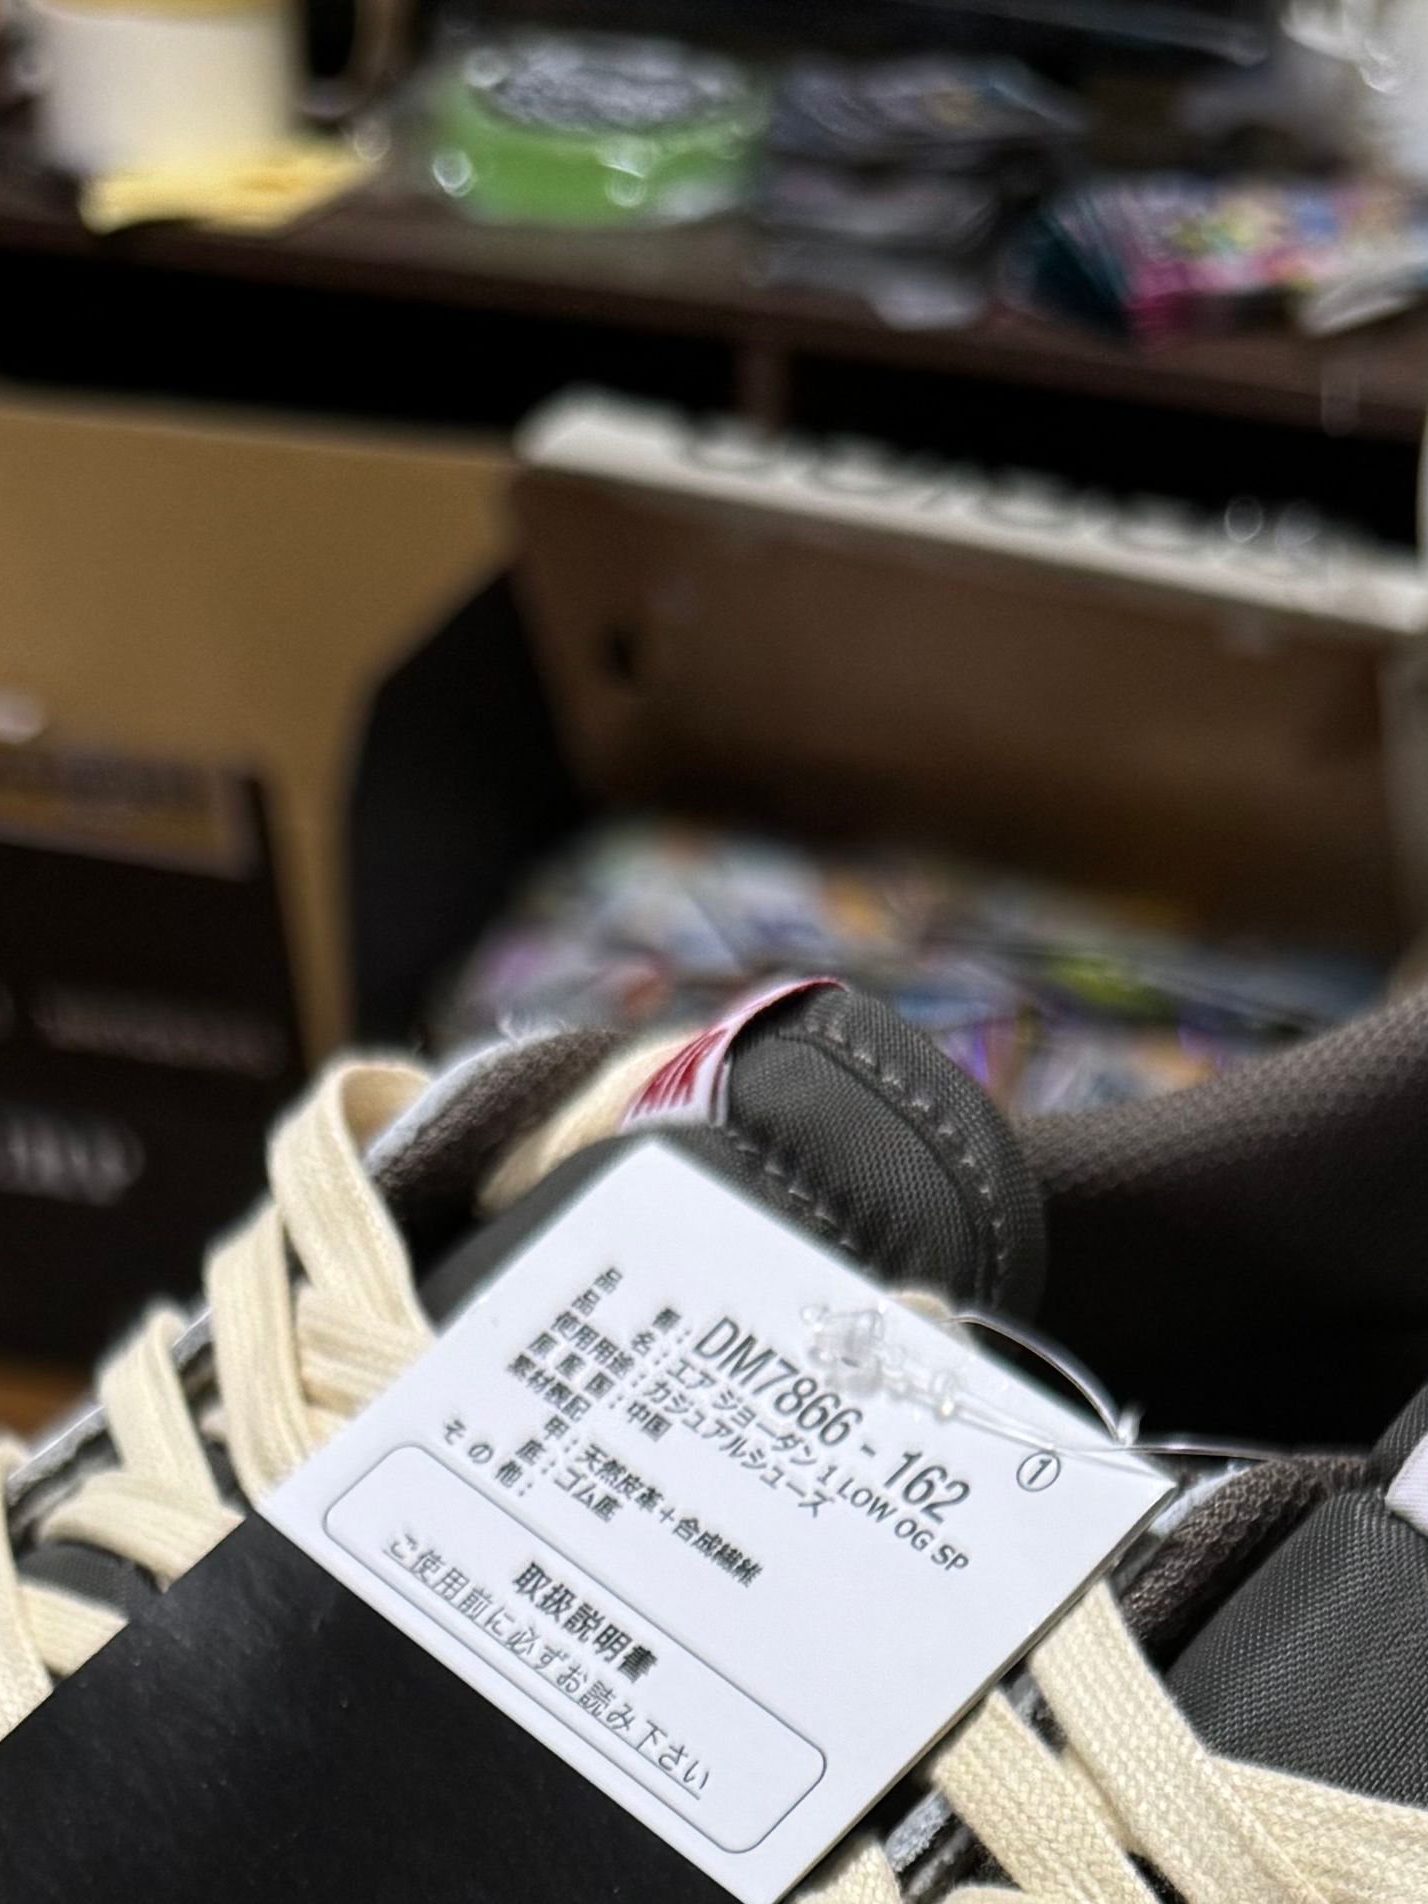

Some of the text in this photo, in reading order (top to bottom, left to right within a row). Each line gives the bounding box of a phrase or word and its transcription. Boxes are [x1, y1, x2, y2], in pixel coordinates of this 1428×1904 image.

[693, 1317, 864, 1447] DM7866
[884, 1452, 972, 1525] 162
[818, 1466, 839, 1486] 1
[837, 1478, 898, 1524] LOW
[895, 1519, 936, 1552] OG
[931, 1544, 970, 1572] SP
[391, 1535, 711, 1791] ご使用前に必ずお読み下さい
[513, 1561, 659, 1685] 取扱説明書
